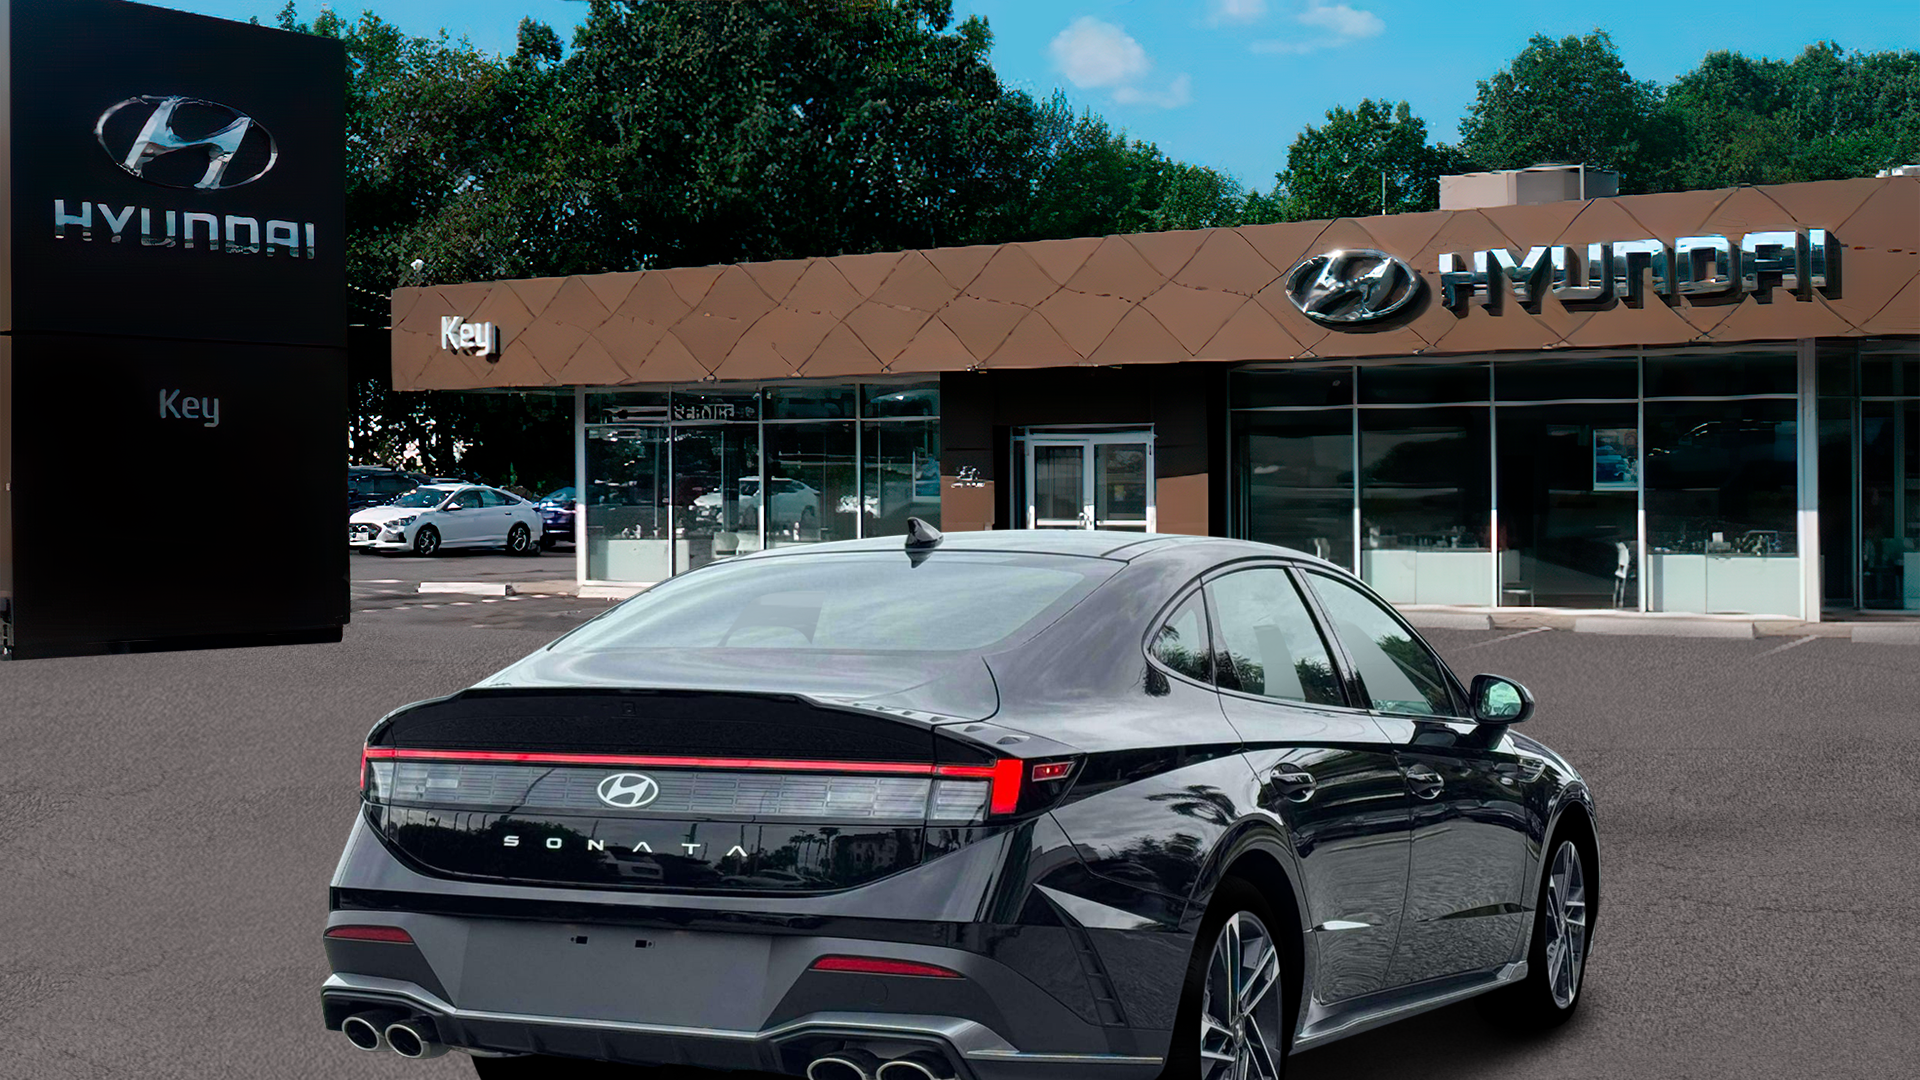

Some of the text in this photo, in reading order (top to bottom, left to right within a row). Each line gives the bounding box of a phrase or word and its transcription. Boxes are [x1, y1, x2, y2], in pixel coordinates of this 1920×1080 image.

[54, 199, 315, 259] HYUNDAI
[1438, 228, 1841, 316] HYUNDAI
[441, 316, 492, 356] Key
[159, 388, 220, 428] Key
[503, 835, 749, 857] SONATA
